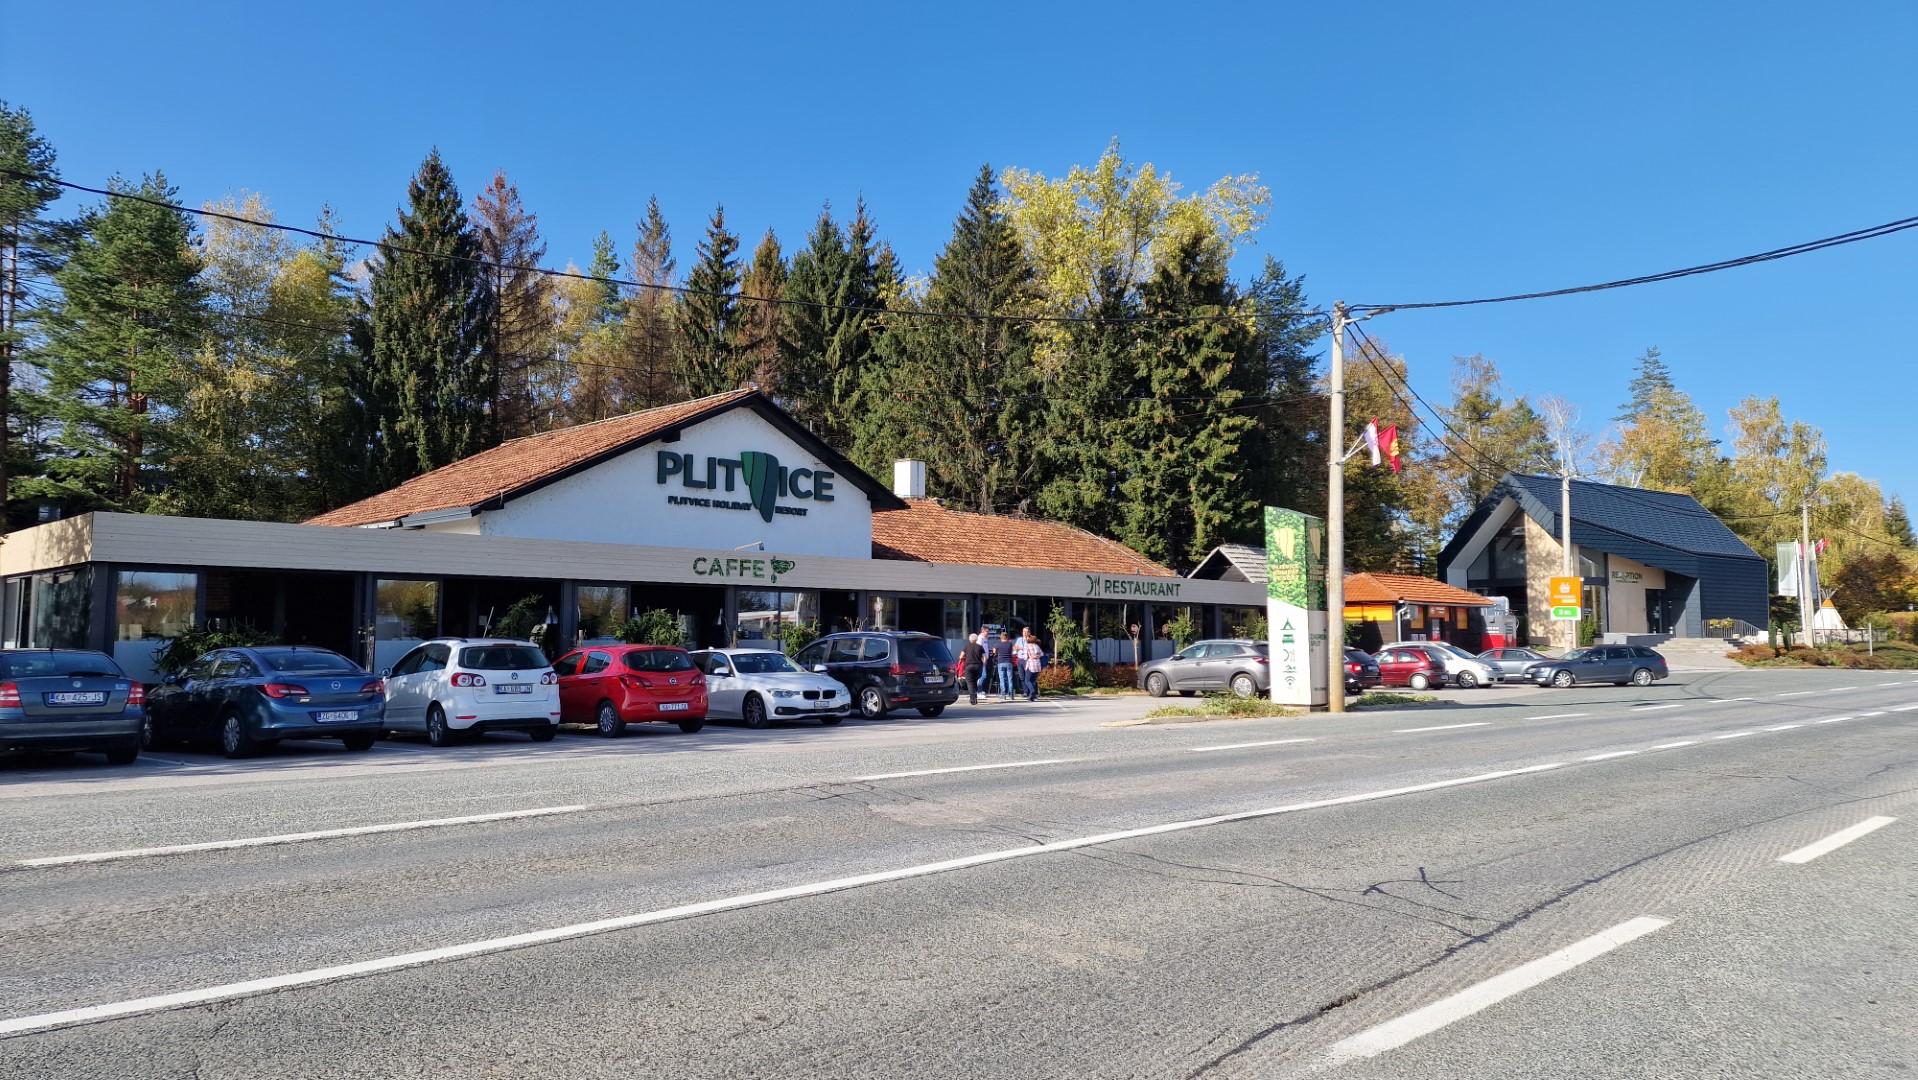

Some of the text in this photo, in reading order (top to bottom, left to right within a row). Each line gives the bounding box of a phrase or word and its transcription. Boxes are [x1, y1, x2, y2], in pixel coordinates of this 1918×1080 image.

[668, 495, 808, 516] PLITVICE HOLIDAY RESORT
[693, 557, 765, 578] CAFFE
[1104, 579, 1181, 597] RESTAURANT
